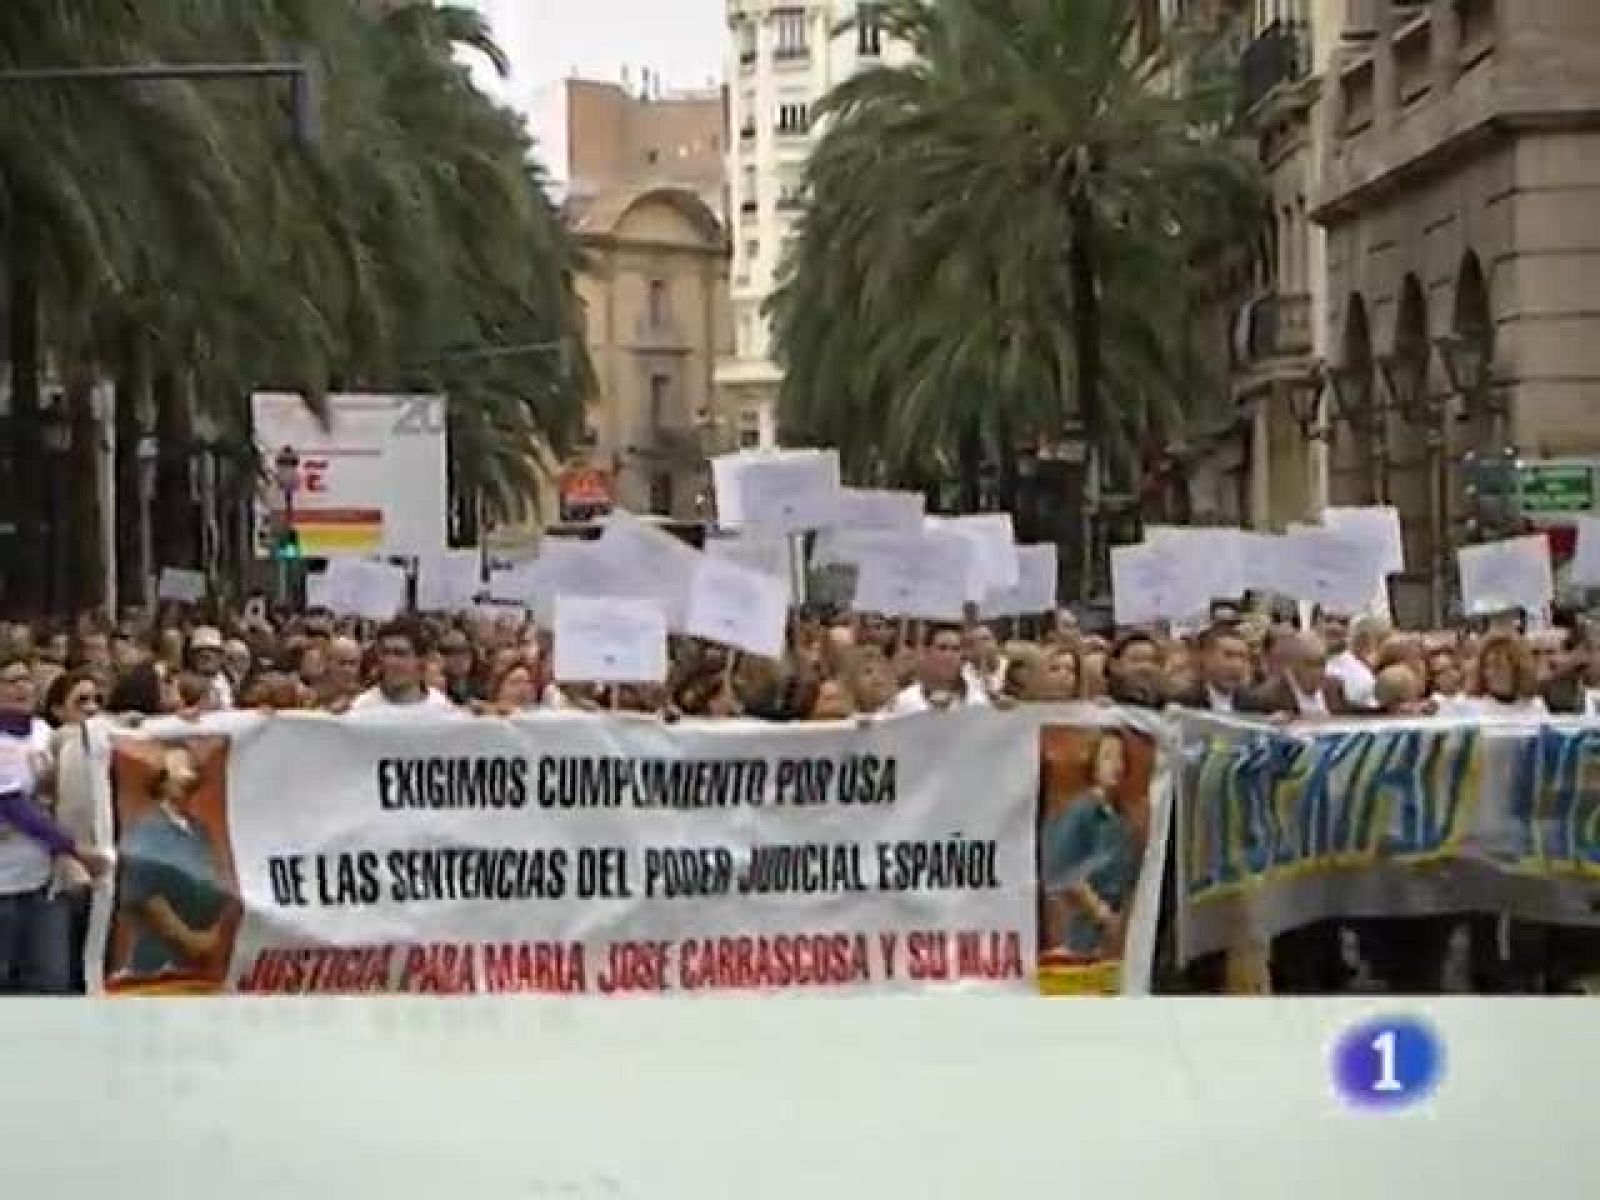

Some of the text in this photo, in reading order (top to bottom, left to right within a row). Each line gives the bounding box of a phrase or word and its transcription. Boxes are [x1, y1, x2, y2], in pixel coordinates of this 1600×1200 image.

[378, 752, 897, 810] EXIGIMOS CUMPLIMIENTO POR USA
[268, 831, 1001, 906] DE LAS SENTENCIAS DEL PODER JUDICIAL ESPAÑOL
[237, 944, 395, 993] JUSTICIA
[400, 943, 476, 993] PARA
[679, 931, 870, 991] CARRASCOSA
[878, 932, 897, 979] Y
[907, 930, 947, 980] SU
